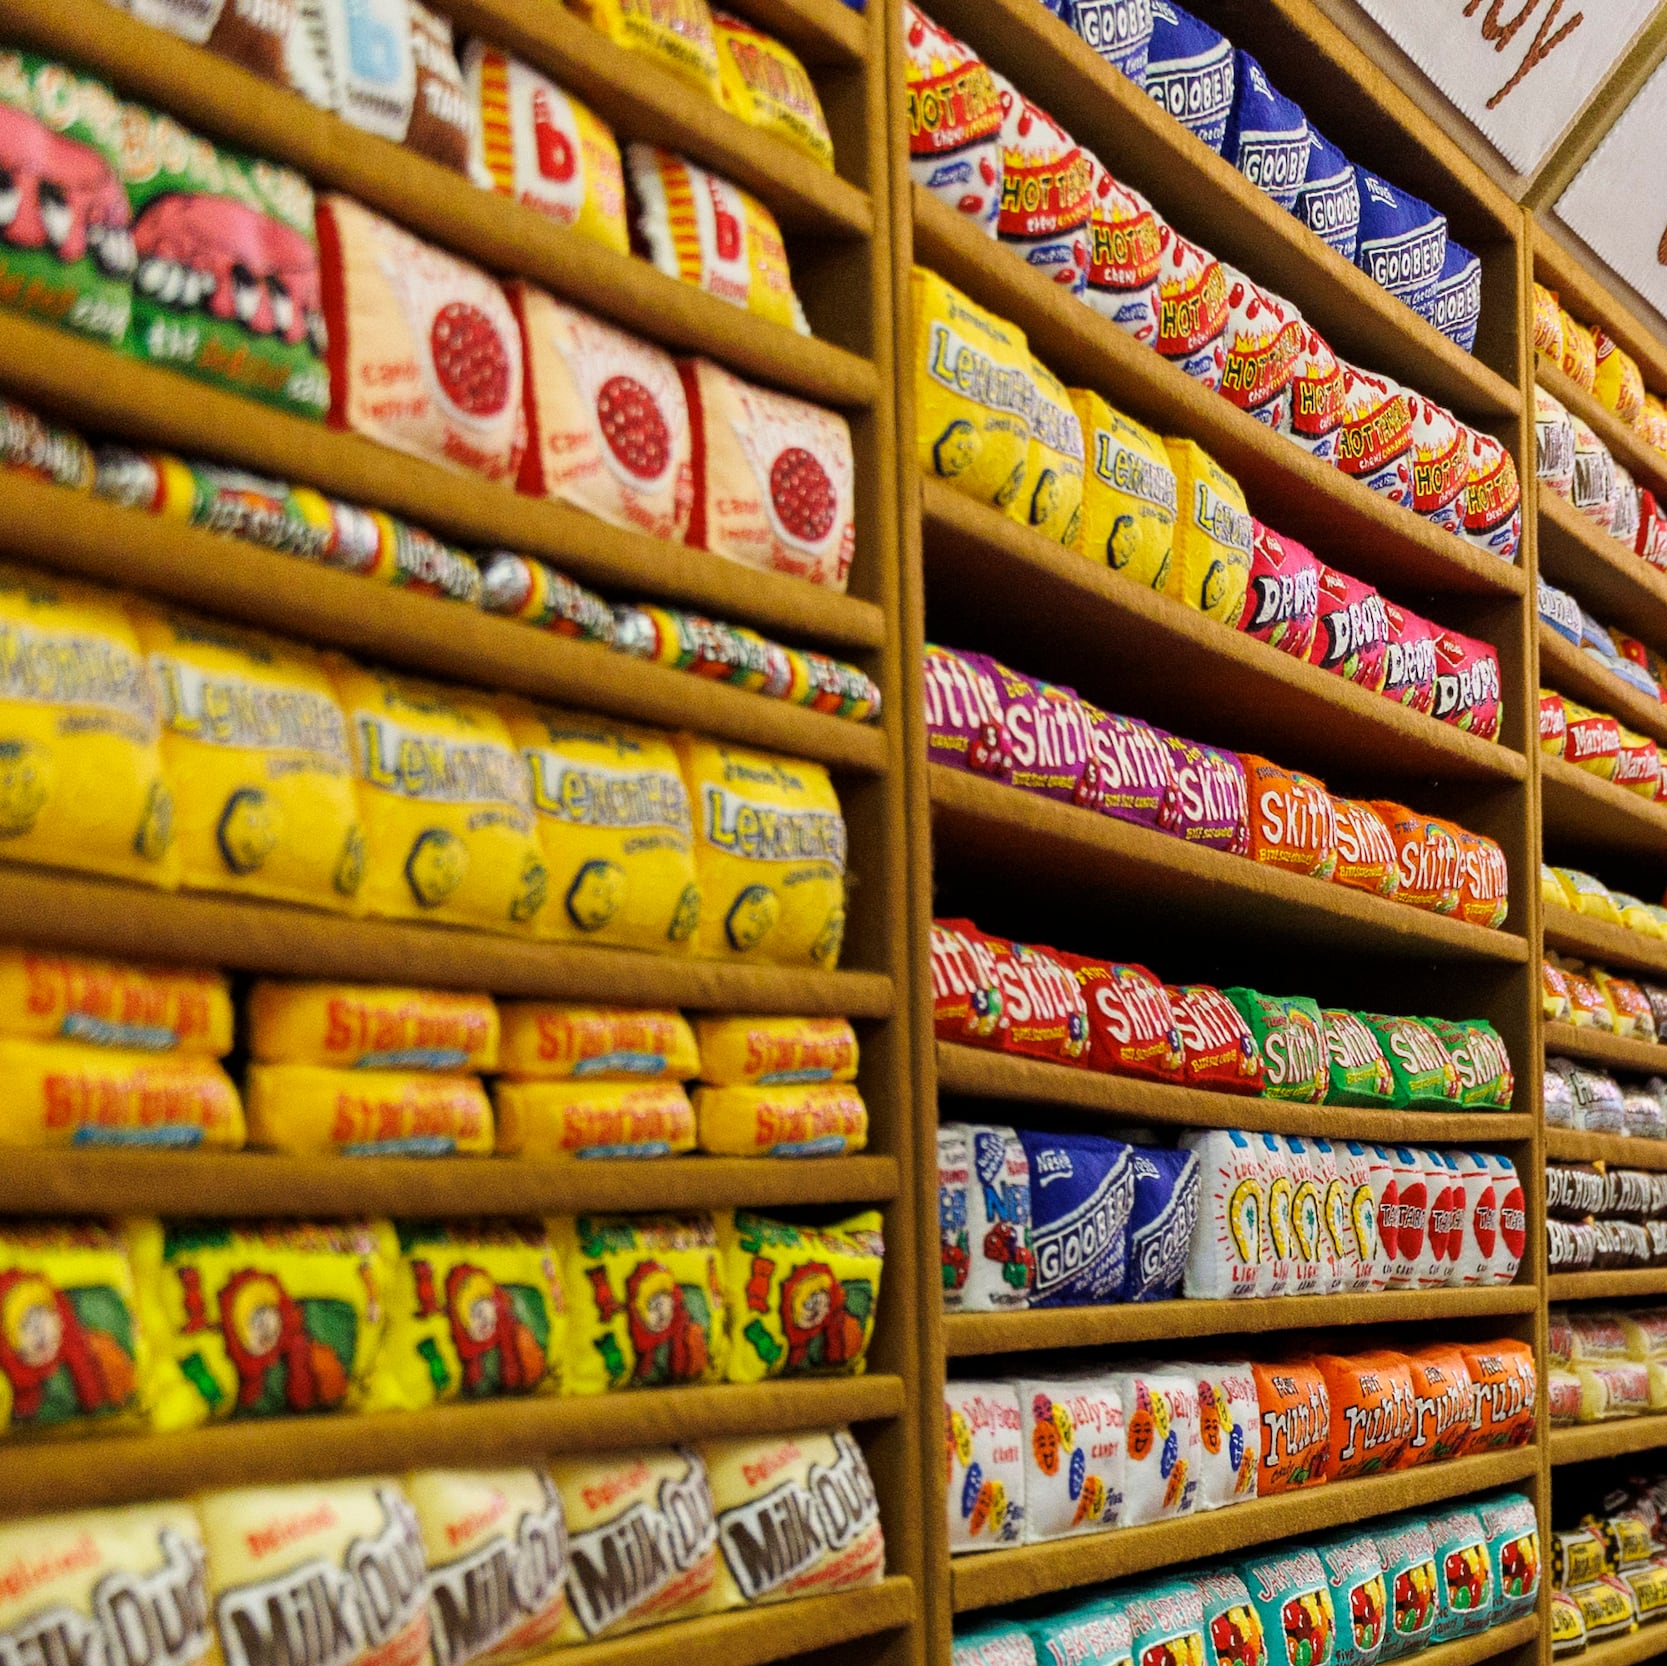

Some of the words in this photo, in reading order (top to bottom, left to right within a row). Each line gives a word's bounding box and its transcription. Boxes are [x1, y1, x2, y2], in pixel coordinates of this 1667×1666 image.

[1244, 143, 1308, 188] GOOBE
[1309, 186, 1360, 229] GOOBE
[1093, 229, 1135, 264] HOT
[1161, 298, 1200, 338] HOT
[1223, 355, 1260, 390] HOT
[1300, 382, 1330, 415] HOT
[1415, 461, 1451, 498] HOT
[1467, 478, 1495, 515] HOT
[1256, 564, 1318, 626] DROPS
[1330, 594, 1389, 661] DROPS
[1388, 636, 1438, 689] DROPS
[1439, 657, 1499, 717] DROPS
[1005, 699, 1099, 769] Skittl
[1260, 783, 1337, 848] Skittl
[1399, 834, 1465, 890] Skittle
[1037, 1180, 1135, 1285] GOOBER
[1263, 1382, 1331, 1467] runts
[1344, 1380, 1414, 1460] runts
[726, 1485, 818, 1585] Milk
